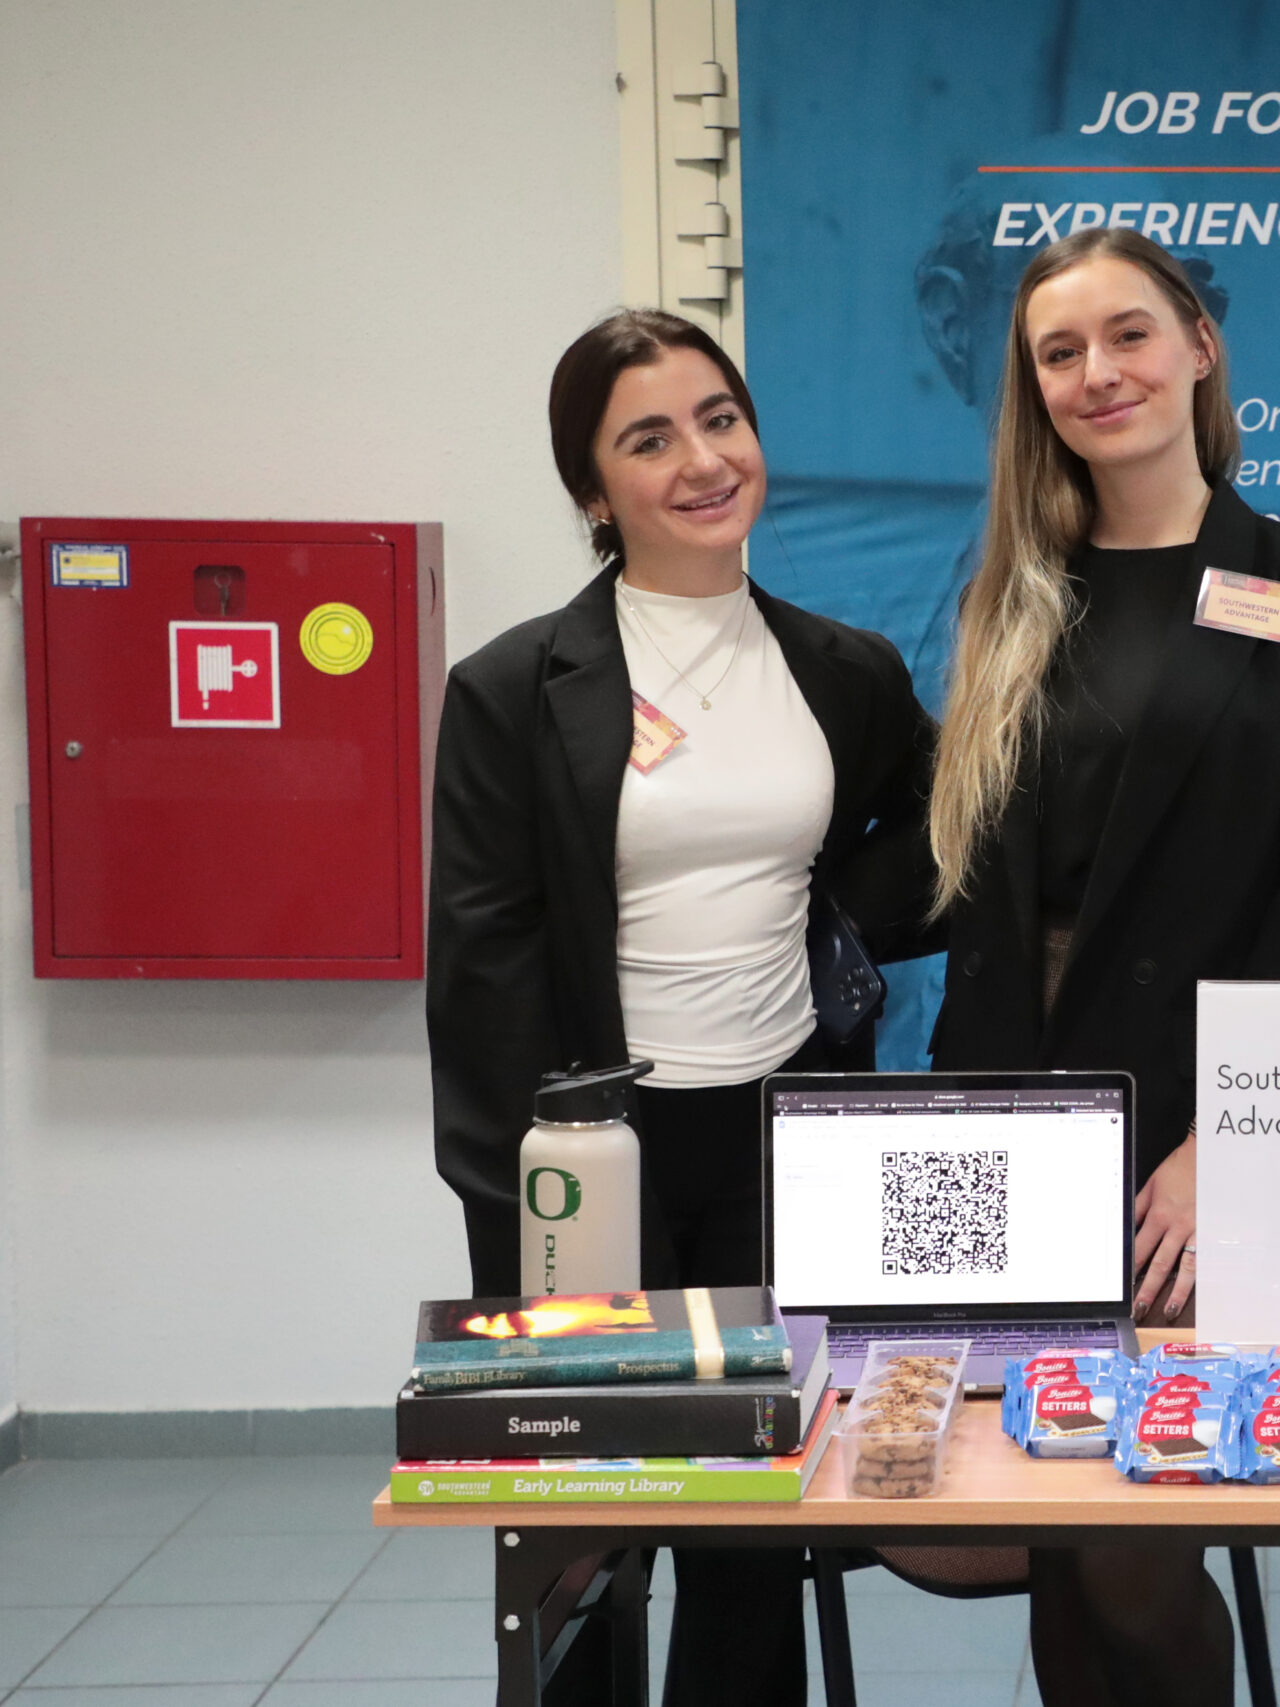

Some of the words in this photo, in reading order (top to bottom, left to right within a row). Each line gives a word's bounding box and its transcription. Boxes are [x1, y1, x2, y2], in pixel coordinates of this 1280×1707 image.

[1081, 91, 1201, 135] JOB
[1218, 597, 1280, 617] SOUTHWESTERN
[1224, 608, 1269, 623] ADVANTAGE
[526, 1166, 582, 1221] O
[617, 1360, 680, 1377] Prospectus
[1041, 1401, 1087, 1411] SETTERS
[507, 1416, 581, 1437] Sample
[1143, 1424, 1190, 1436] SETTERS
[513, 1479, 553, 1497] Early
[556, 1478, 626, 1496] Learning
[629, 1477, 685, 1496] Library
